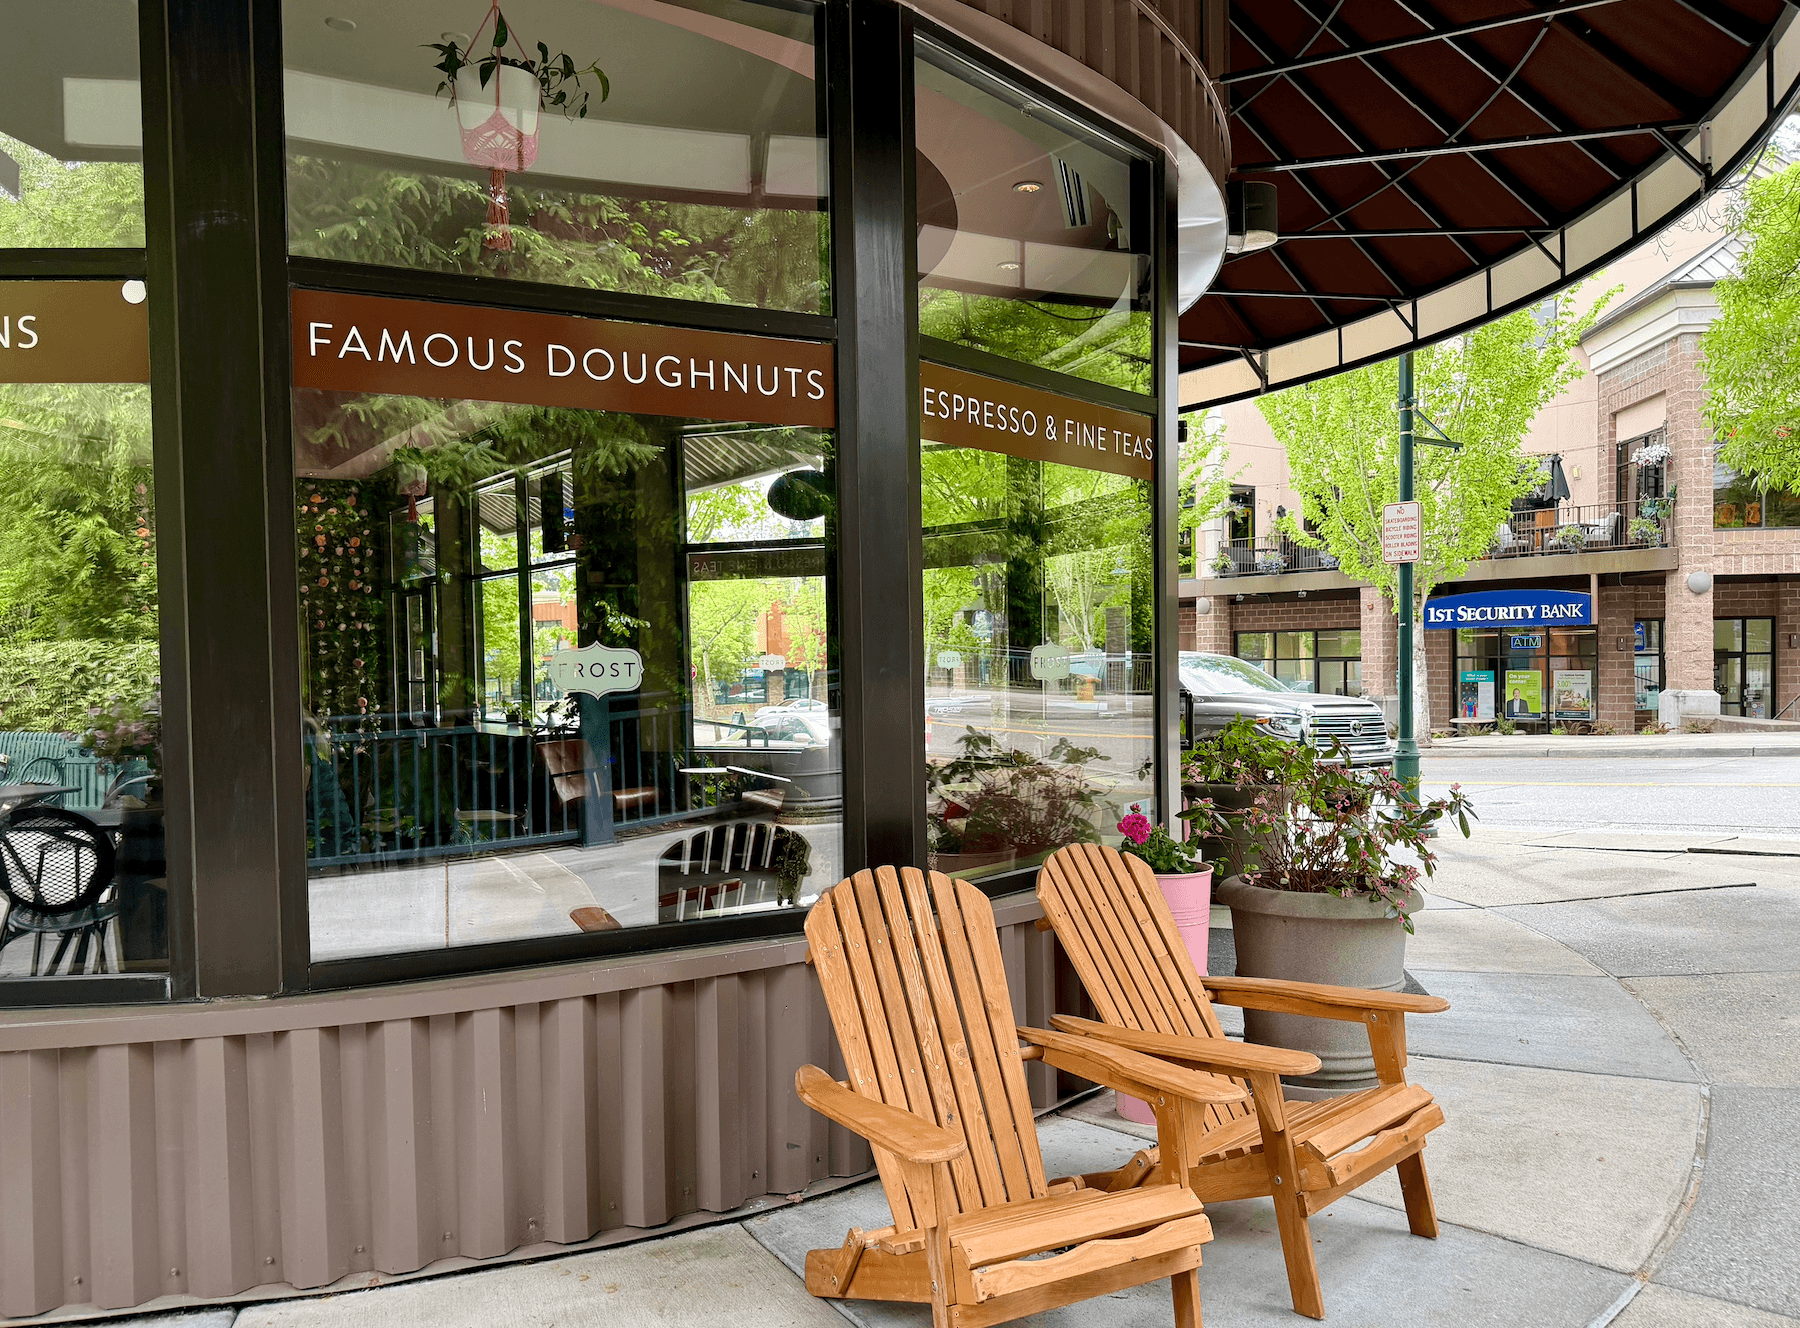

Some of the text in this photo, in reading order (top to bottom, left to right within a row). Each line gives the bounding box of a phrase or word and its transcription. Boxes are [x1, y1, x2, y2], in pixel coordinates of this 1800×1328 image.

[309, 321, 826, 400] FAMOUS DOUGHNUTS
[923, 387, 1154, 461] ESPRESSO & FINE TEAS
[1428, 604, 1584, 623] 1ST SECURITY BANK
[1513, 637, 1540, 648] ATM
[559, 662, 636, 678] FROST
